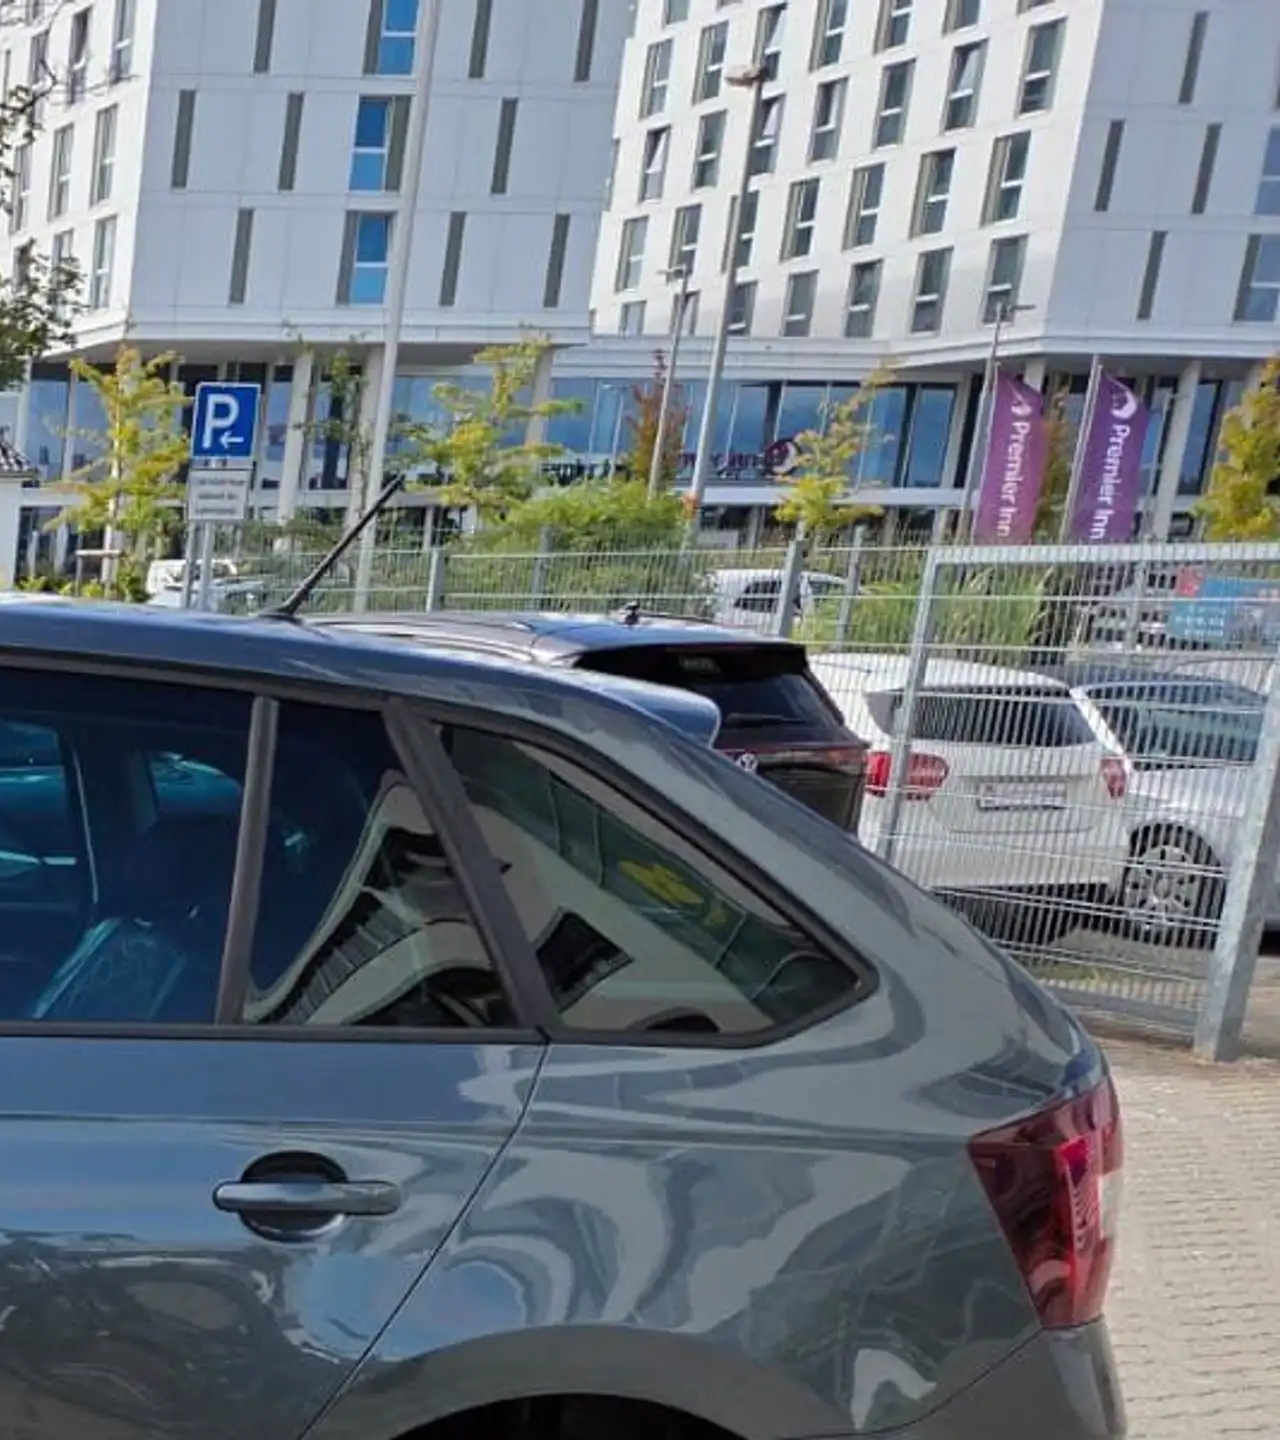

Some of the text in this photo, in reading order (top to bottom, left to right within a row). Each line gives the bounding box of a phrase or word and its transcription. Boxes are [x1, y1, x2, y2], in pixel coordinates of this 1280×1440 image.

[202, 393, 239, 449] P
[997, 421, 1031, 537] Premier Inn
[1090, 424, 1131, 539] Premier Inn
